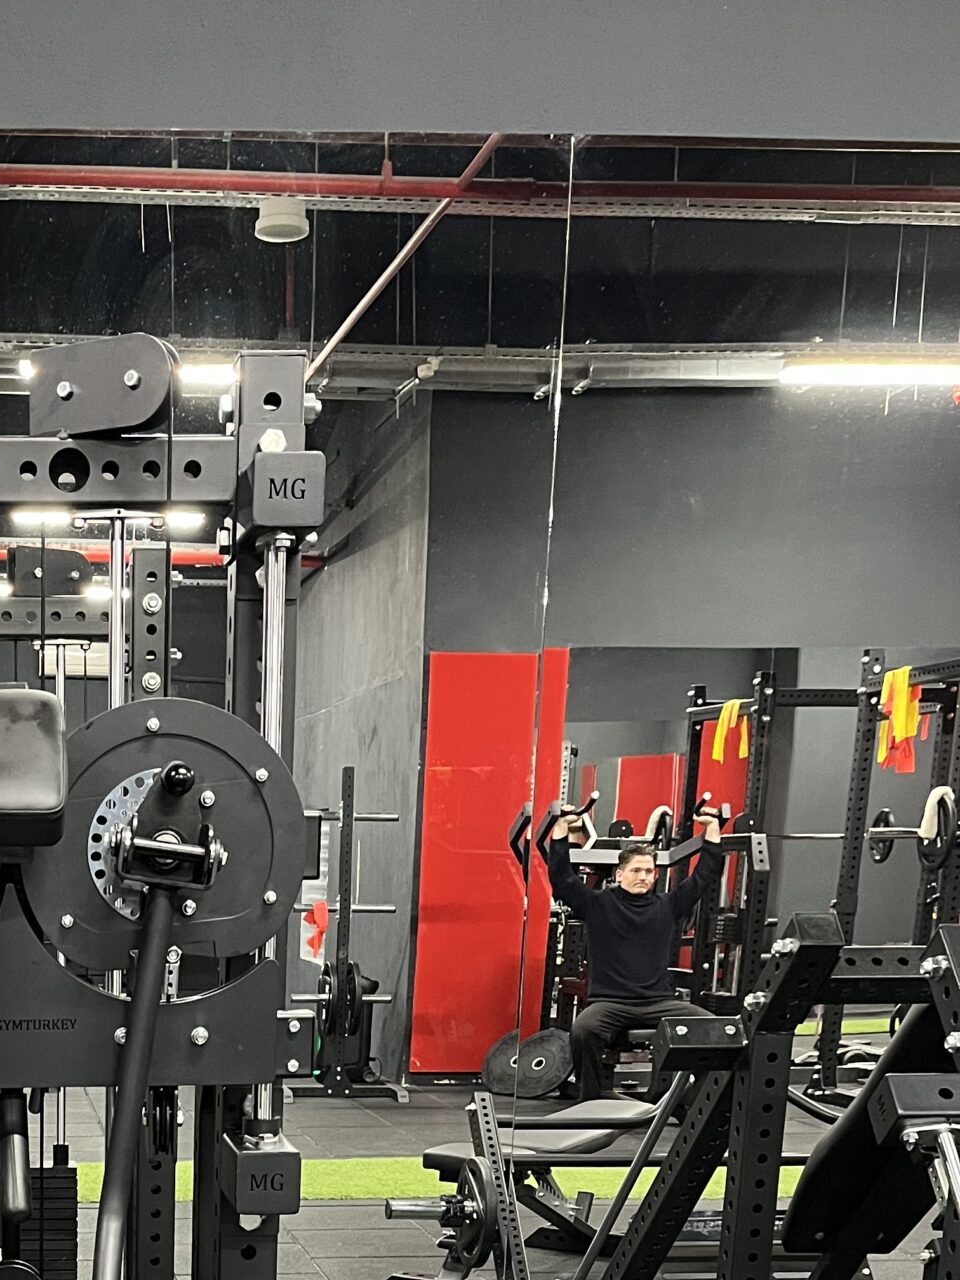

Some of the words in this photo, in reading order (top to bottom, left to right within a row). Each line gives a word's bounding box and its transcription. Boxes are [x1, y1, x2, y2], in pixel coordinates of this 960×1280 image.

[267, 477, 306, 500] MG
[121, 810, 128, 819] 9
[249, 1172, 285, 1192] MG
